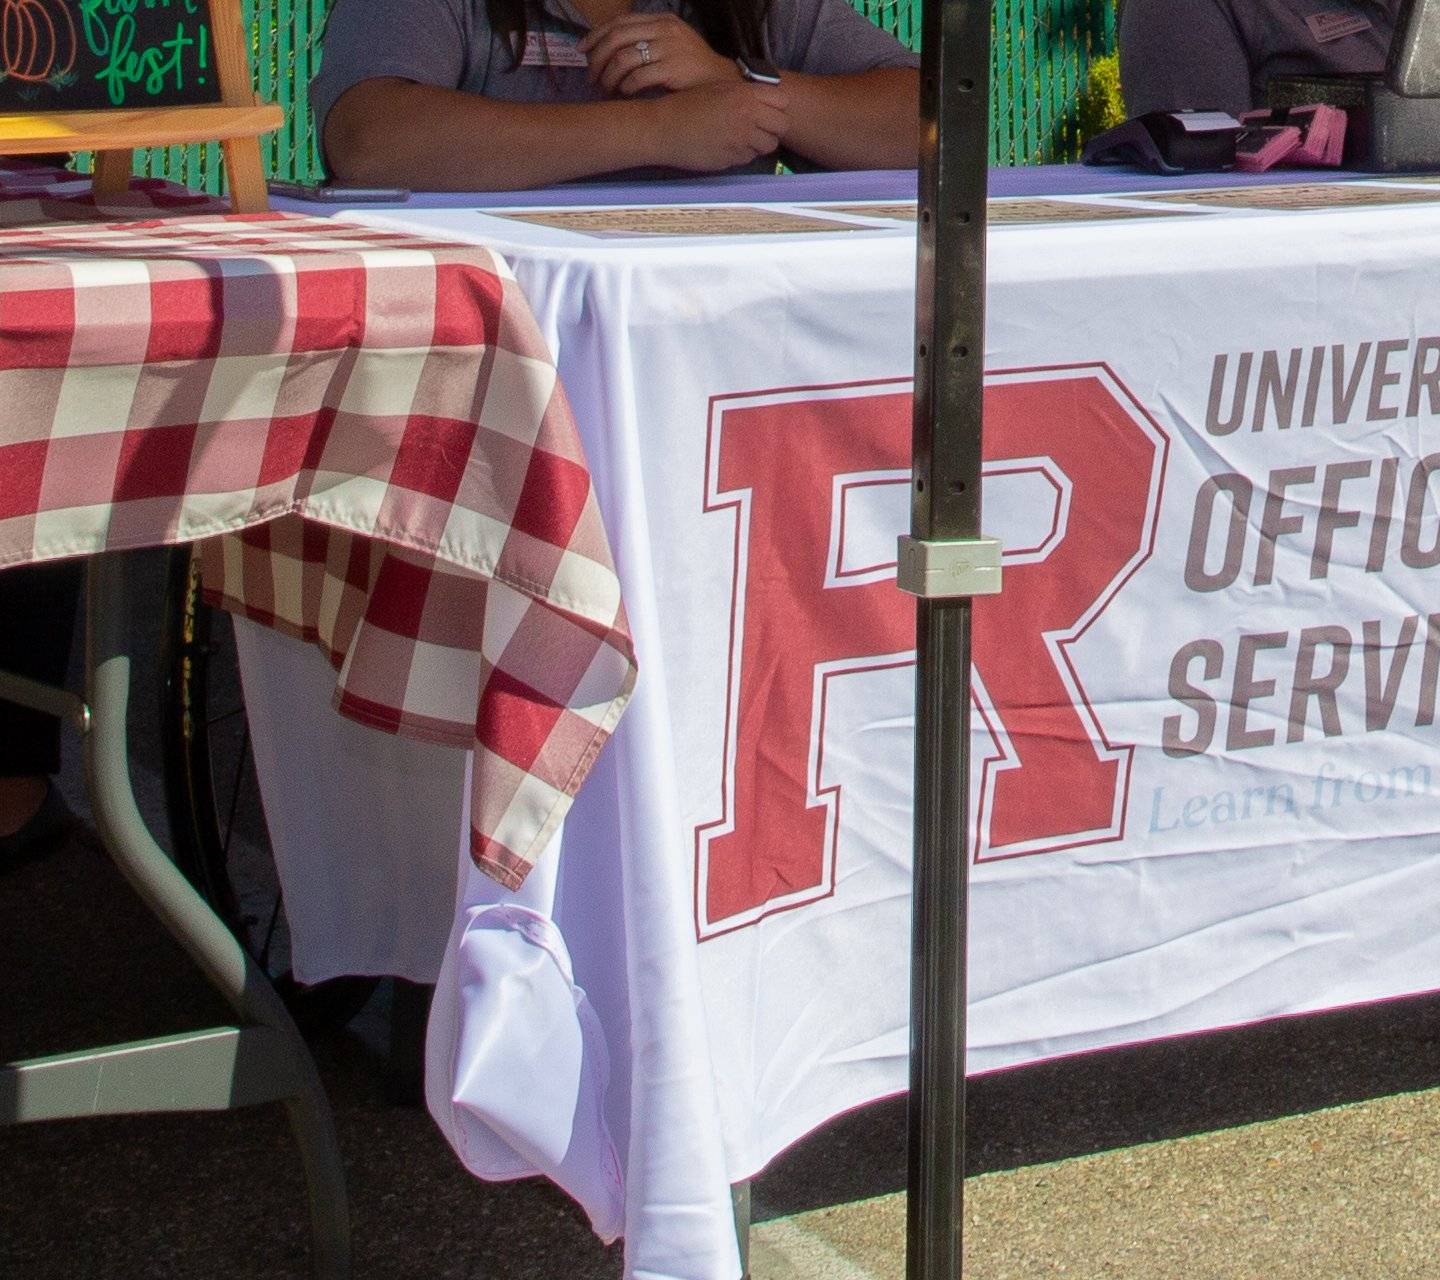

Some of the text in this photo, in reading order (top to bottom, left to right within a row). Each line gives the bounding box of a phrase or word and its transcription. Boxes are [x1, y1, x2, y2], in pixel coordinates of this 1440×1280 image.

[95, 14, 208, 106] fest!
[695, 361, 1171, 943] R
[1147, 780, 1302, 835] Learn
[1311, 758, 1434, 815] from
